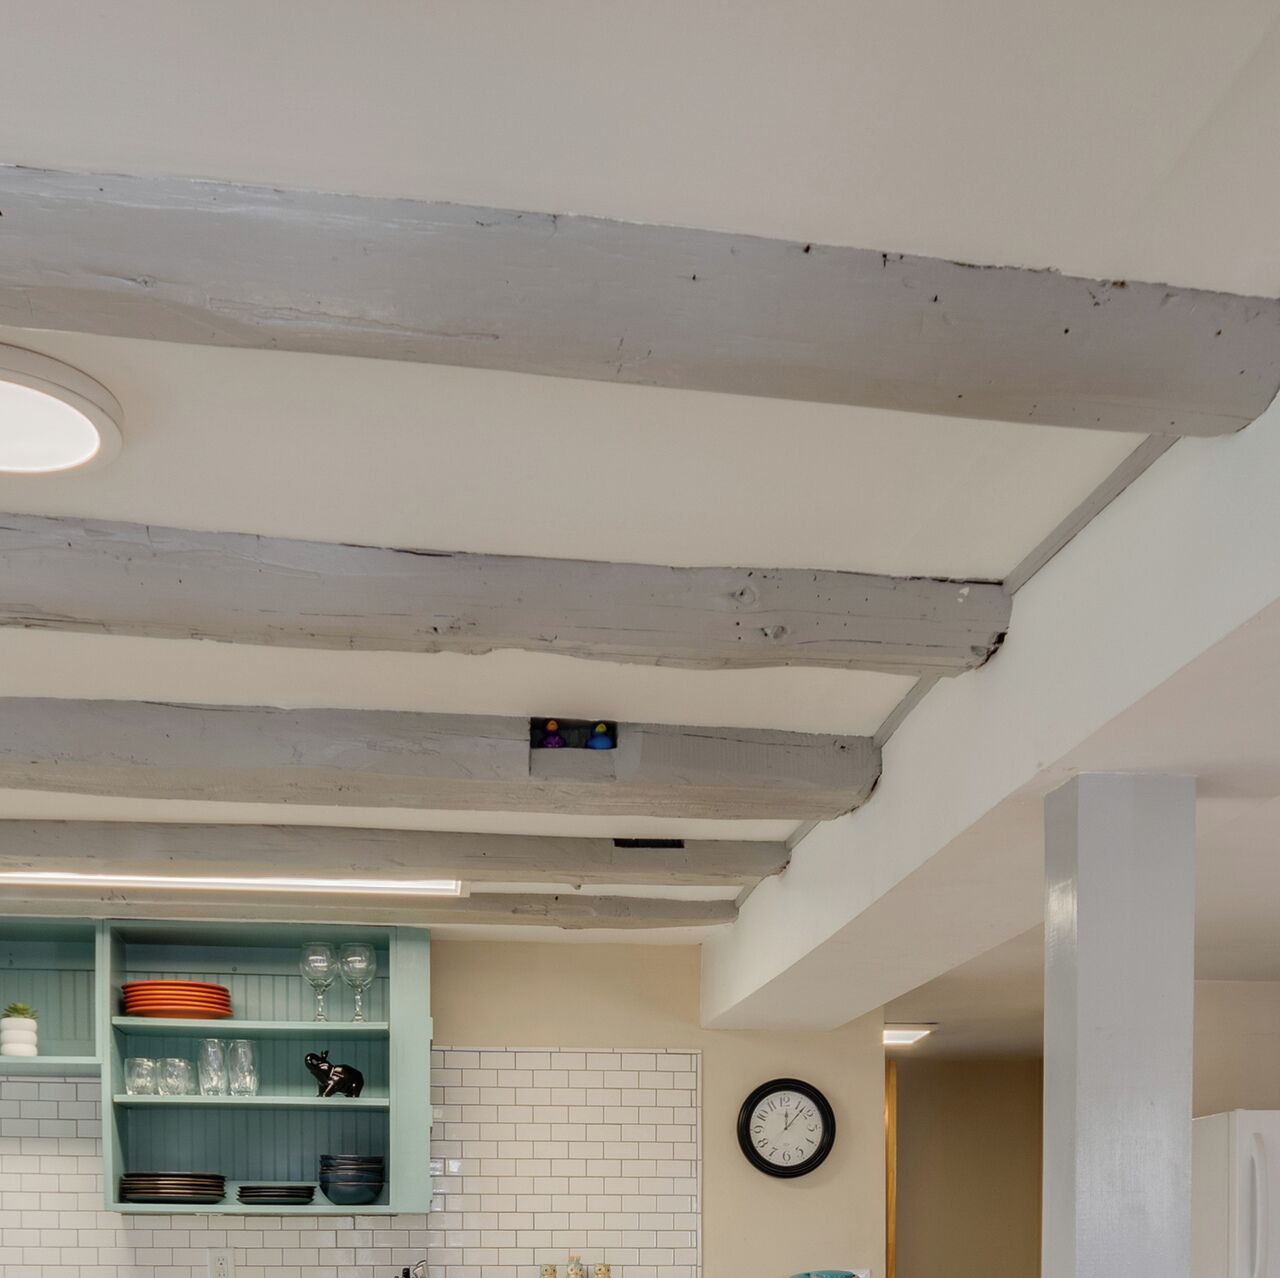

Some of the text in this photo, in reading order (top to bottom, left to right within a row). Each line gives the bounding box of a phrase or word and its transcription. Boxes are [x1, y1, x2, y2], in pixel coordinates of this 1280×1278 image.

[780, 1096, 790, 1108] 12
[754, 1124, 764, 1134] 9
[757, 1138, 768, 1148] 8
[768, 1146, 778, 1157] 7
[782, 1151, 791, 1162] 6
